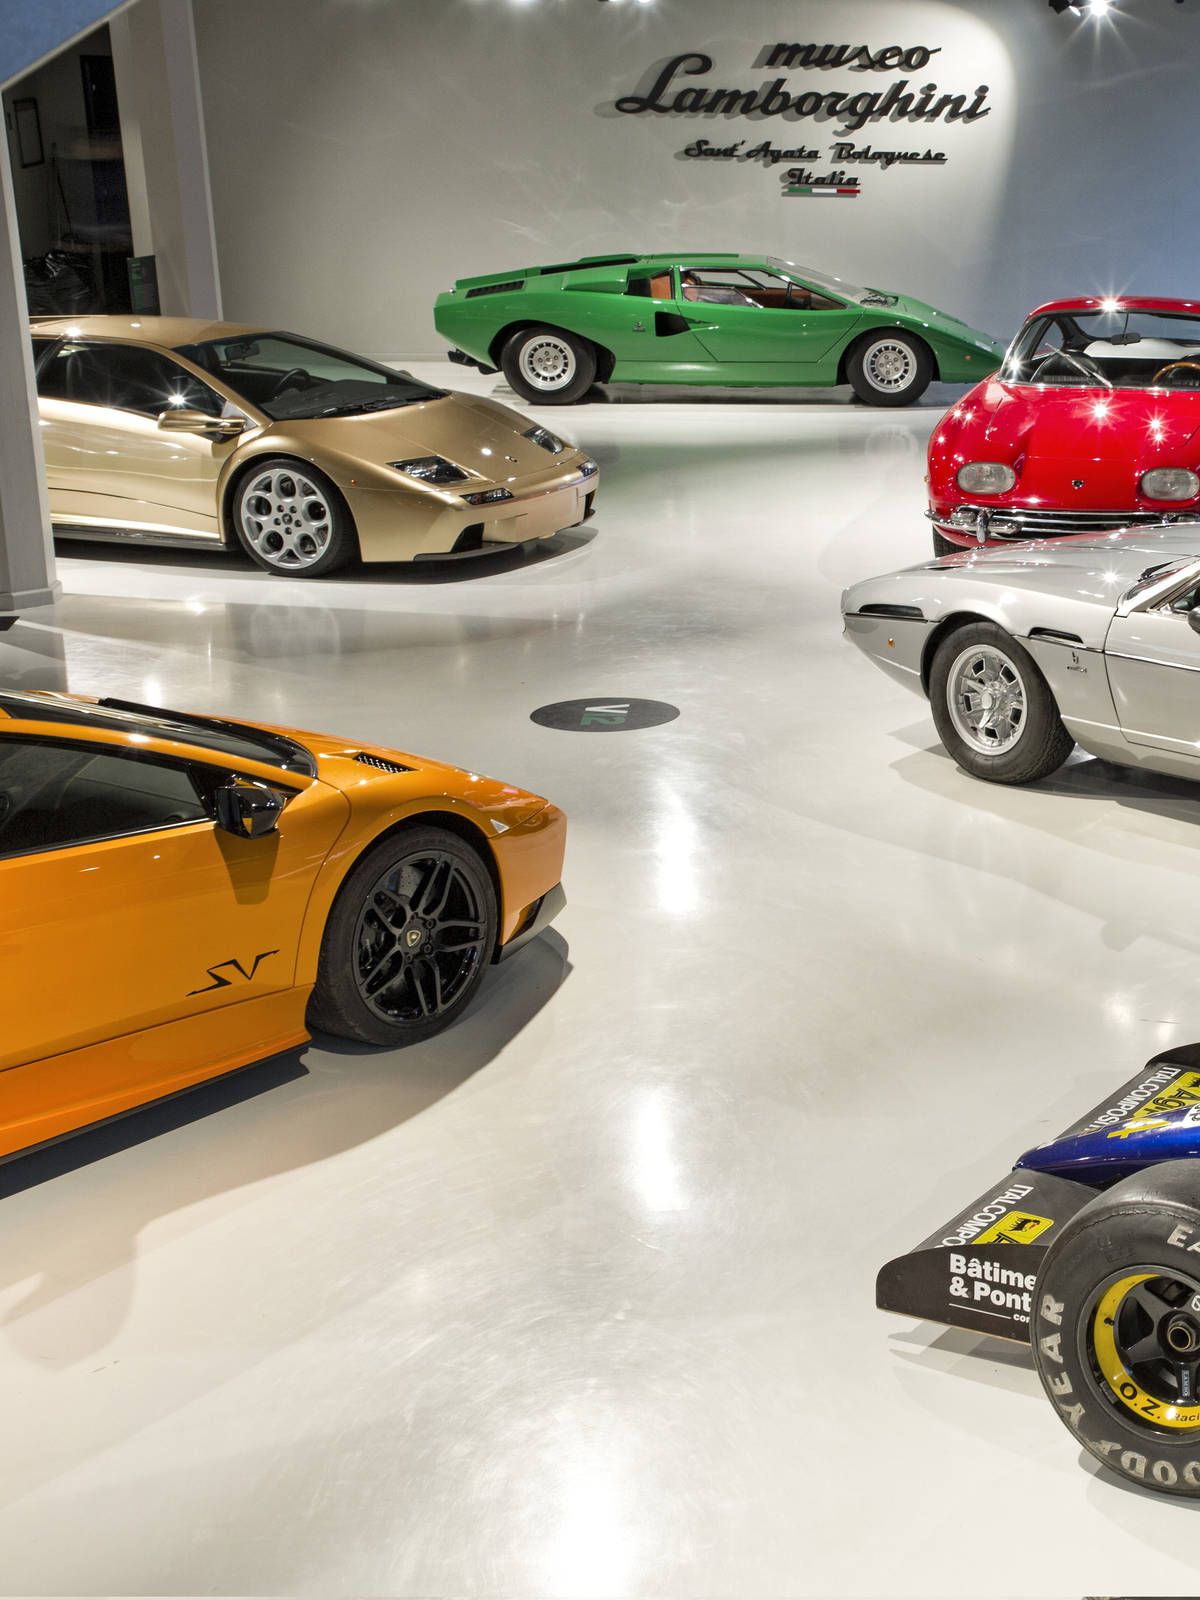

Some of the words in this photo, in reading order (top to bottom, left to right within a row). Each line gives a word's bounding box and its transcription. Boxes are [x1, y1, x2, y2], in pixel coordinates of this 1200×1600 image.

[765, 42, 942, 70] museo
[614, 53, 992, 131] Lamborghini
[787, 167, 861, 186] Italia
[949, 1252, 1038, 1291] Bâtime
[949, 1276, 969, 1299] &
[973, 1281, 1032, 1313] Pont
